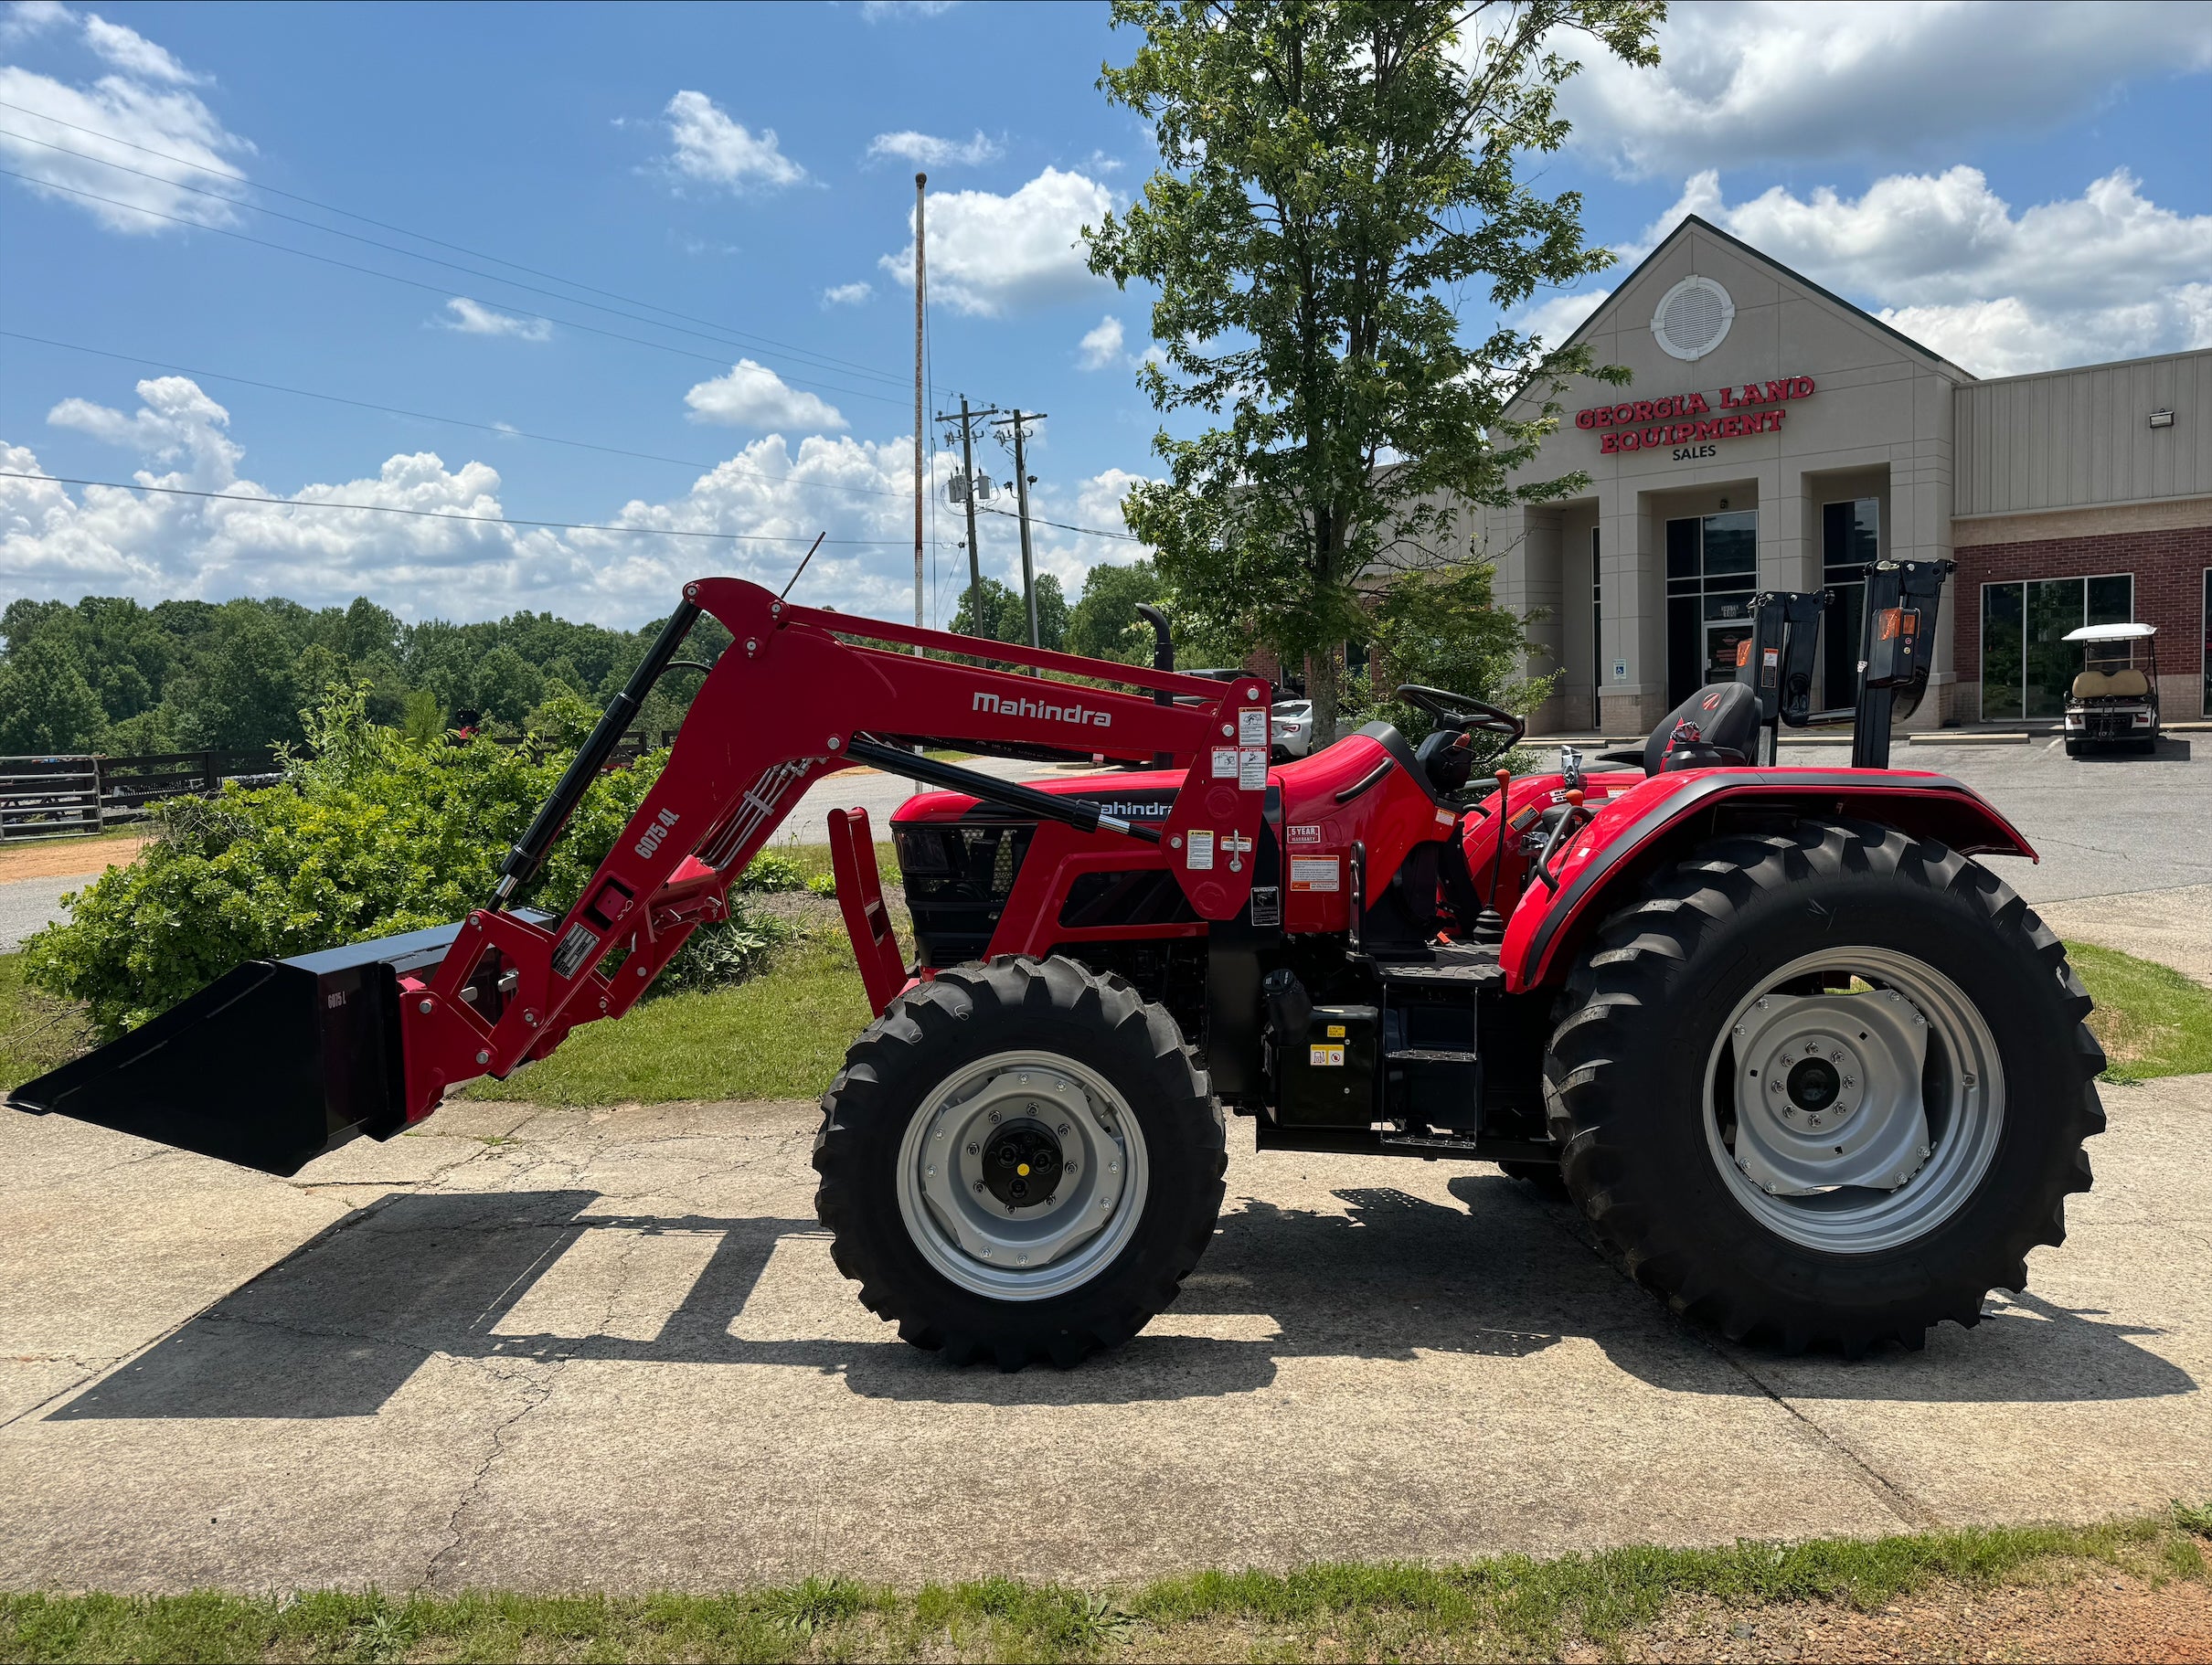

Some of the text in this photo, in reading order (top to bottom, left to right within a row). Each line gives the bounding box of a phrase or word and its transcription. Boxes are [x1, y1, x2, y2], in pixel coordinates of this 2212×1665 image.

[1575, 376, 1815, 430] GEORGIA LAND
[1601, 409, 1786, 454] EQUIPMENT
[1672, 445, 1717, 461] SALES
[972, 692, 1112, 727] Mahindra
[634, 808, 680, 860] 6075 4L
[1297, 827, 1315, 835] YEAR
[327, 992, 342, 1009] 6075
